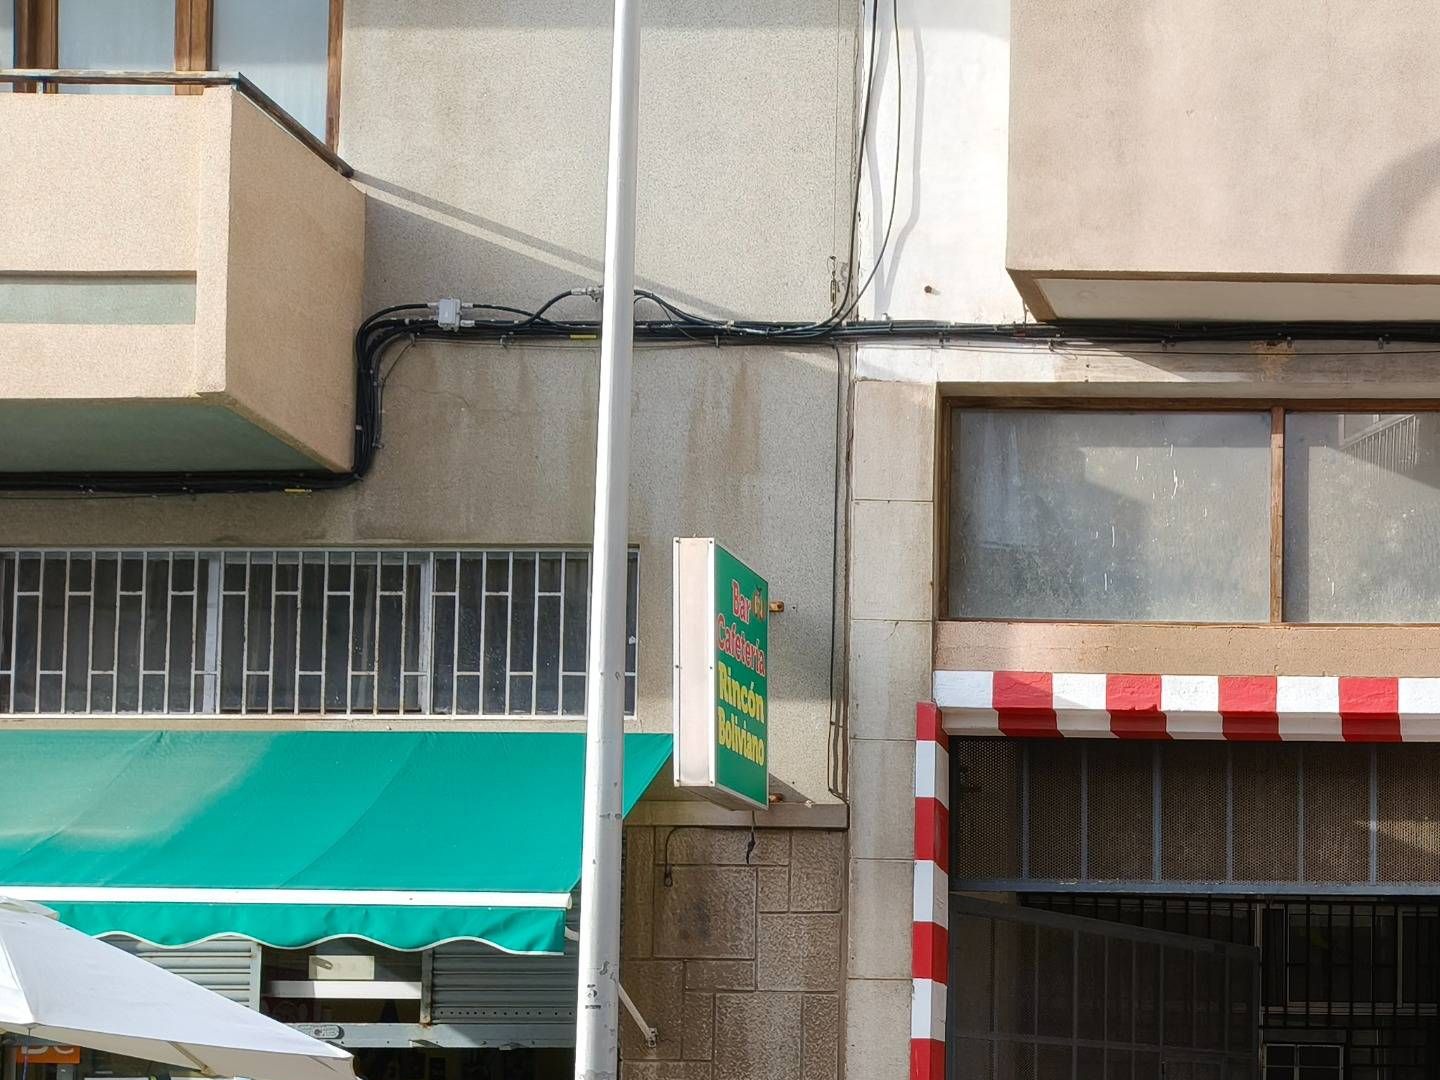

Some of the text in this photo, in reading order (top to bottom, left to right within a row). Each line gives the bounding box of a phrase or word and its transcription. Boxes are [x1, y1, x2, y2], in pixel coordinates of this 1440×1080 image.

[732, 579, 751, 624] Bar
[717, 613, 766, 677] Cafetería
[718, 661, 765, 724] Rincón
[717, 707, 765, 767] Boliviano
